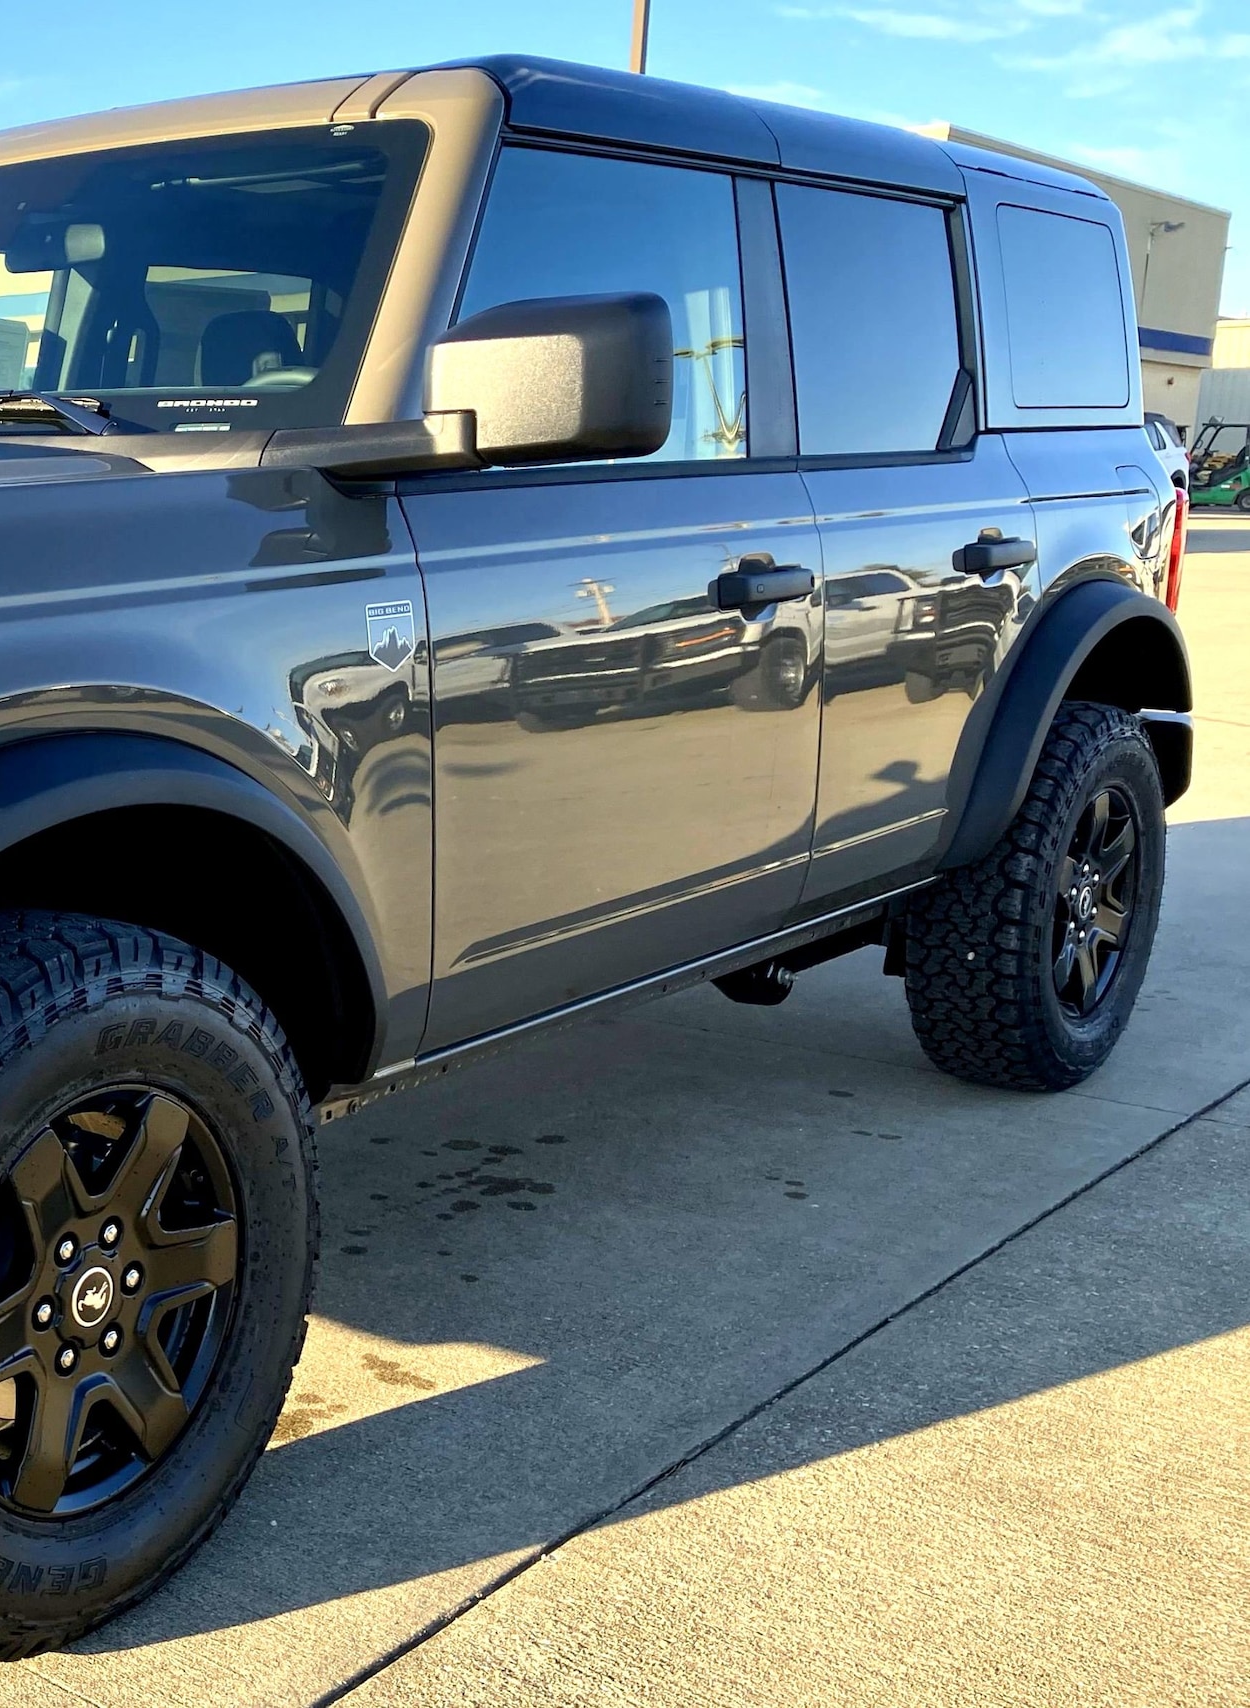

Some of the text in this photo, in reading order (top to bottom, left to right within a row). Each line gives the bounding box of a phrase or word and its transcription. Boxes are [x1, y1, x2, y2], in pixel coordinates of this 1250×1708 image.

[368, 605, 410, 616] BIG BEND
[96, 1018, 275, 1122] GRABBER
